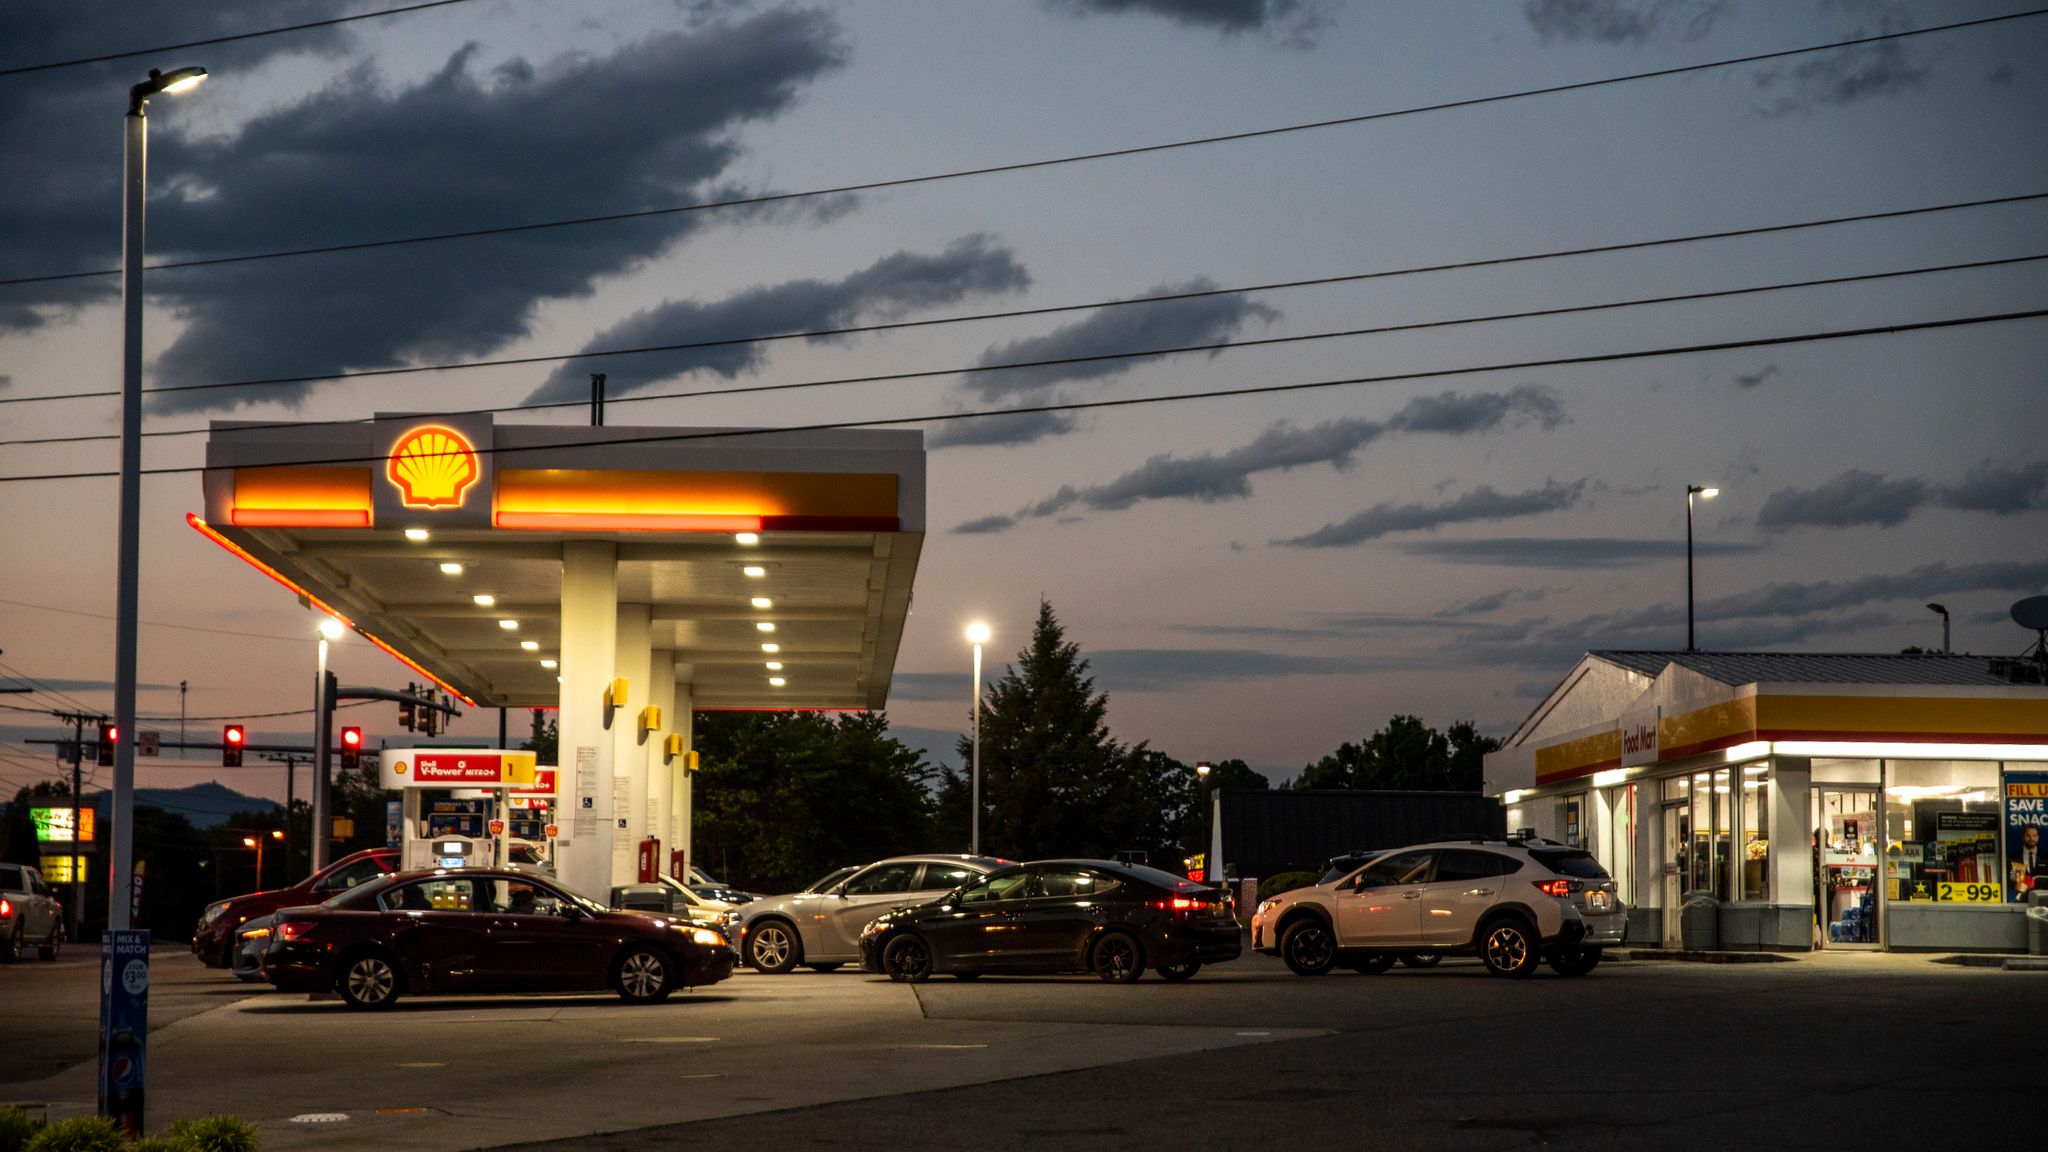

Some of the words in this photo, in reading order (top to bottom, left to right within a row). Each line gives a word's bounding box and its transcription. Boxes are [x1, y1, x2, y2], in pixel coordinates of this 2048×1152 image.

[1624, 724, 1639, 754] Food
[1640, 725, 1656, 751] Mart
[420, 767, 462, 776] V-Power
[507, 763, 513, 776] 1
[2008, 784, 2034, 796] FILL
[2009, 798, 2044, 811] SAVE
[538, 845, 545, 854] 3
[1940, 884, 1953, 901] 2
[117, 935, 134, 944] MIX
[135, 935, 141, 944] &
[116, 945, 146, 954] MATCH
